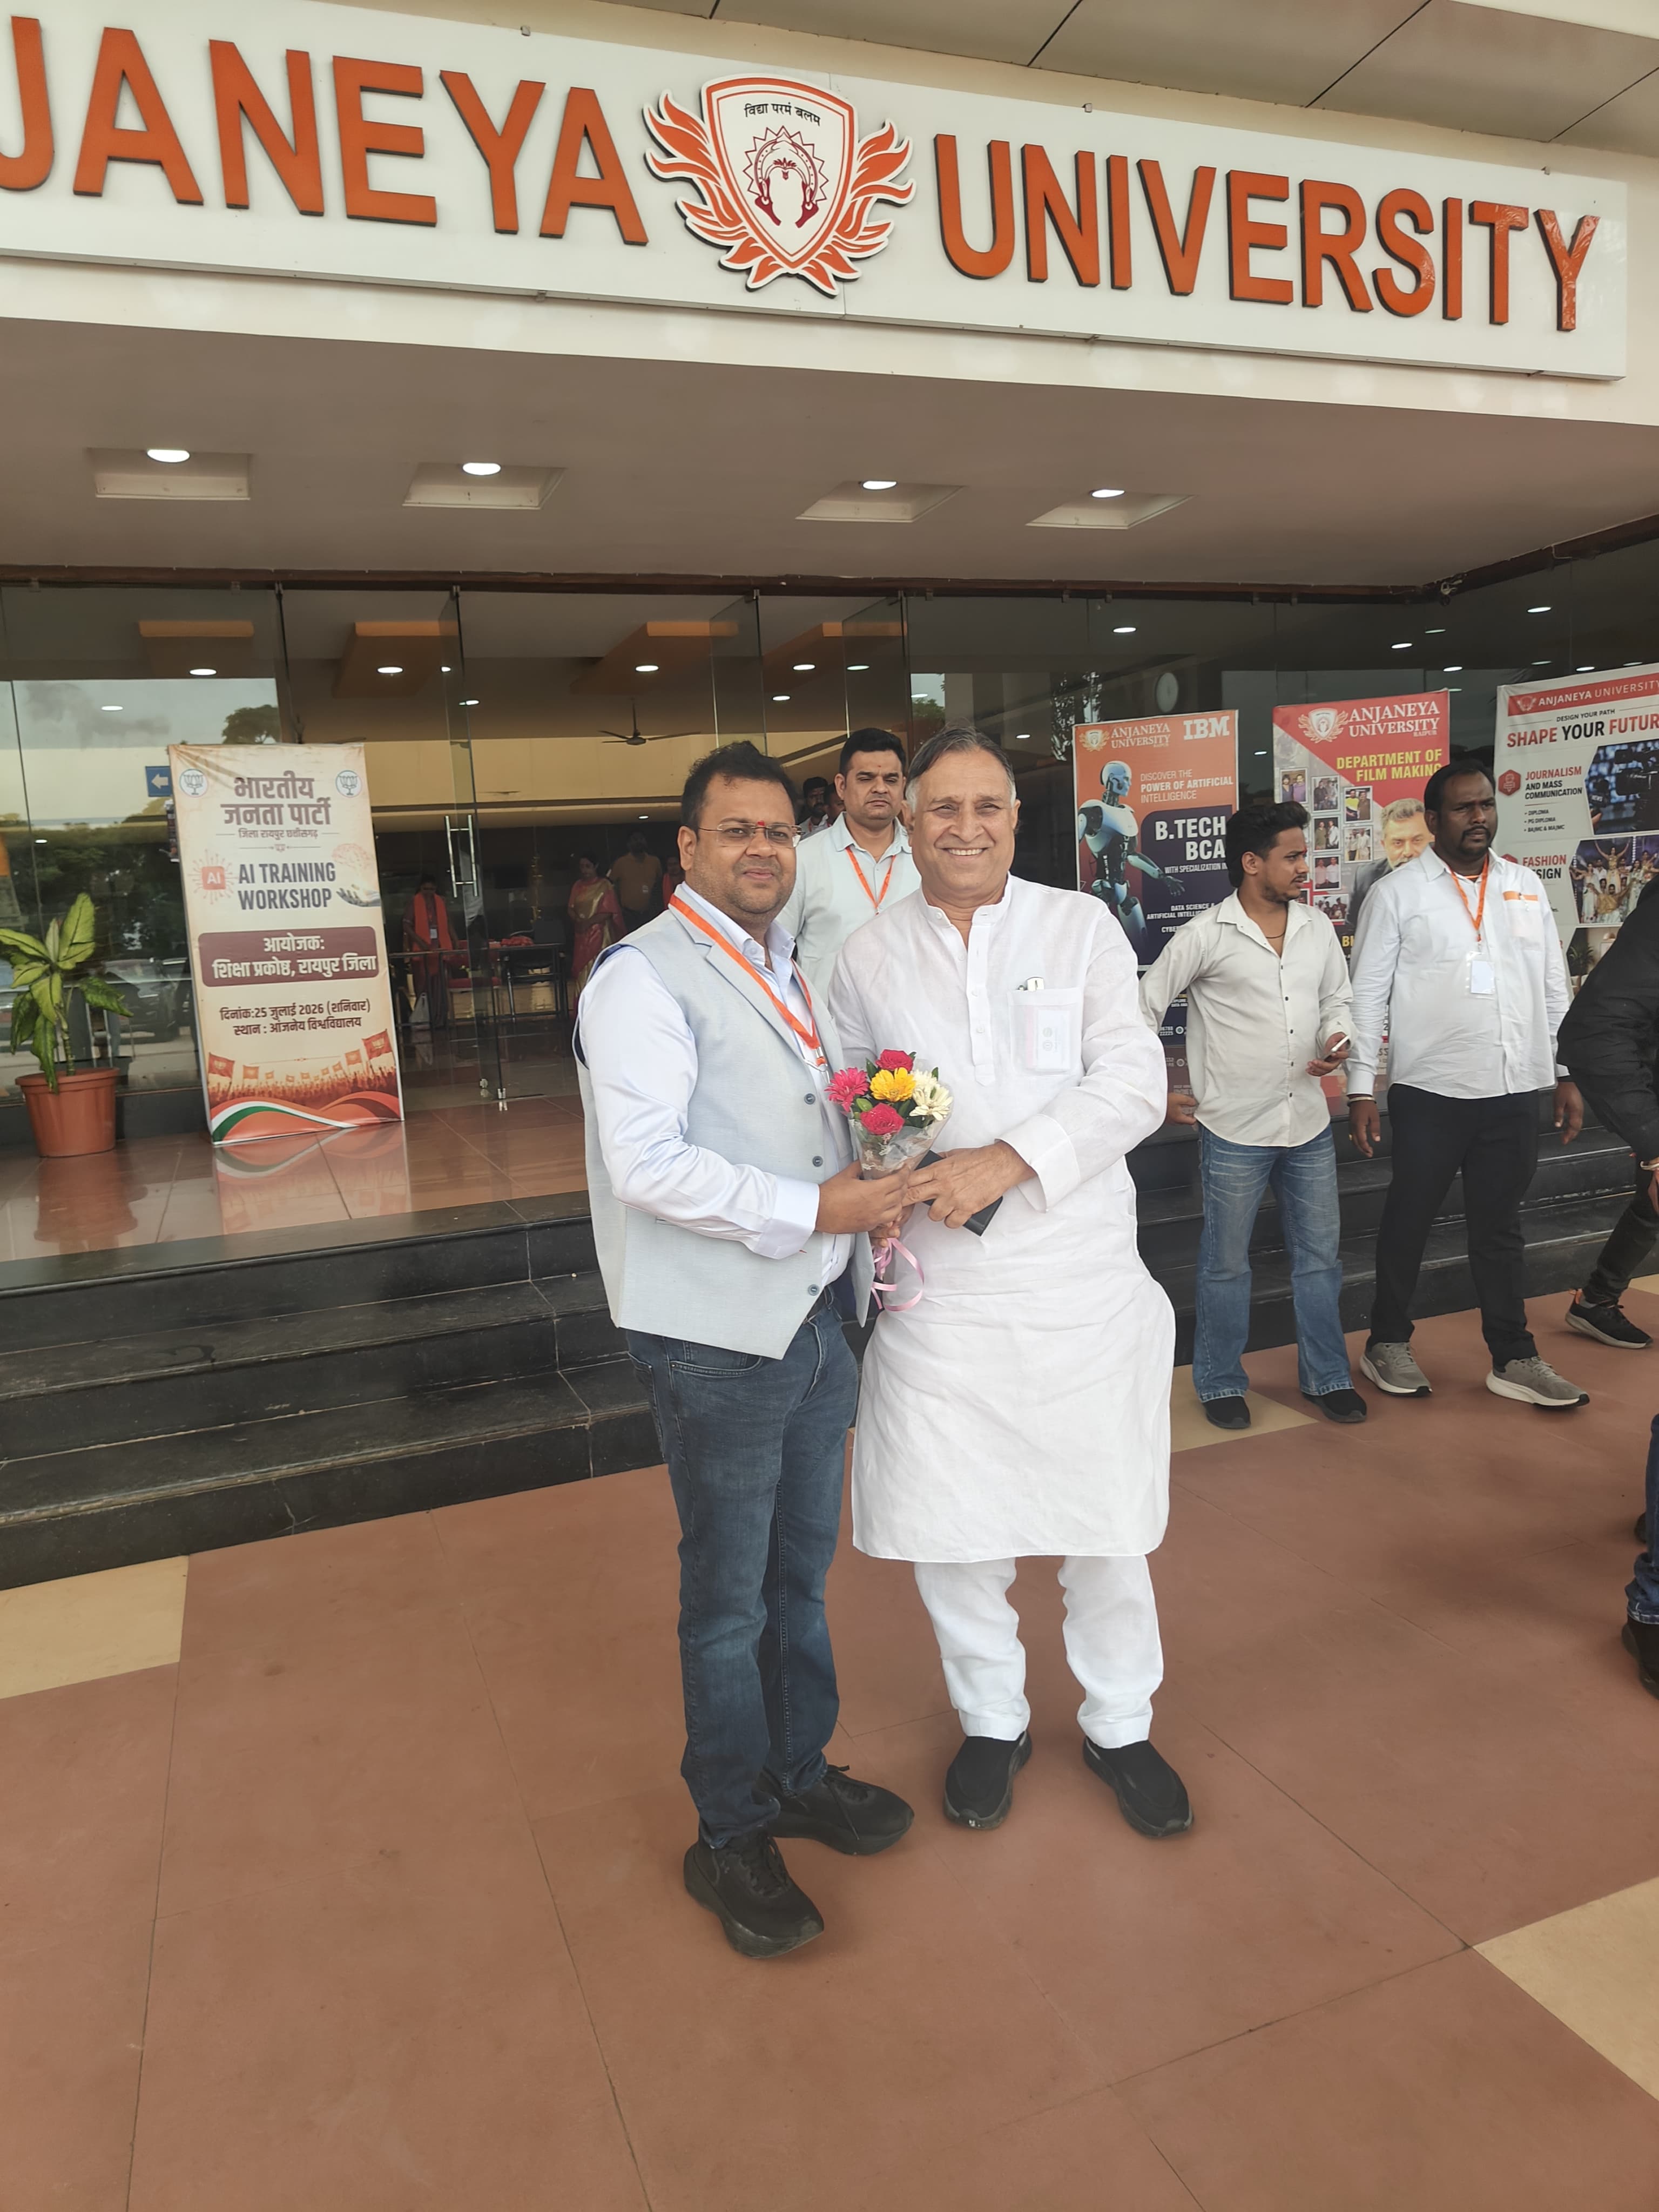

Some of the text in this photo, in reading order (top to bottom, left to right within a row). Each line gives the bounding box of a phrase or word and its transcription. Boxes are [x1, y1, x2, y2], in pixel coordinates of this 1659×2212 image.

[744, 103, 769, 117] विद्या
[794, 106, 821, 126] बलम
[934, 133, 1601, 332] UNIVERSITY
[1539, 691, 1592, 706] ANJANEYA
[1348, 701, 1440, 724] ANJANEYA
[1556, 713, 1579, 722] DESIGN
[1581, 711, 1597, 719] YOUR
[1111, 723, 1171, 739] ANJANEYA
[1183, 716, 1230, 740] IBM
[1349, 717, 1440, 738] UNIVERSITY
[1507, 727, 1557, 748] SHAPE
[1562, 720, 1605, 741] YOUR
[1111, 734, 1171, 749] UNIVERSITY
[1337, 748, 1442, 769] DEPARTMENT OF
[1141, 769, 1192, 782] DISCOVER THE
[1356, 768, 1387, 782] FILM
[1525, 766, 1582, 780] JOURNALISM
[234, 771, 314, 799] भारतीय
[1141, 776, 1233, 793] POWER OF ARTIFICIAL
[1525, 787, 1583, 800] COMMUNICATION
[1526, 780, 1562, 791] AND MASS
[1141, 790, 1197, 804] INTELLIGENCE
[220, 797, 331, 826] जनता पार्टी
[238, 828, 258, 838] जिला
[260, 830, 284, 840] रायपुर
[1155, 815, 1226, 841] B.TECH
[1185, 839, 1226, 861] BCA
[1179, 863, 1221, 873] SPECIALIZATION
[1522, 854, 1567, 867] FASHION
[207, 871, 221, 885] AI
[238, 862, 336, 884] AI TRAINING
[1532, 868, 1561, 879] SIGN
[238, 887, 332, 910] WORKSHOP
[1147, 912, 1176, 920] ARTIFICIAL
[263, 933, 325, 952] आयोजक:
[212, 953, 376, 979] शिक्षा प्रकोष्ठ, रायपुर जिला
[269, 1003, 296, 1020] जुलाई
[299, 1003, 324, 1015] 2026
[327, 999, 371, 1015] (शनिवार)
[233, 1024, 261, 1036] स्थान
[270, 1019, 305, 1033] आंजनेय
[308, 1016, 362, 1030] विश्वविद्यालय
